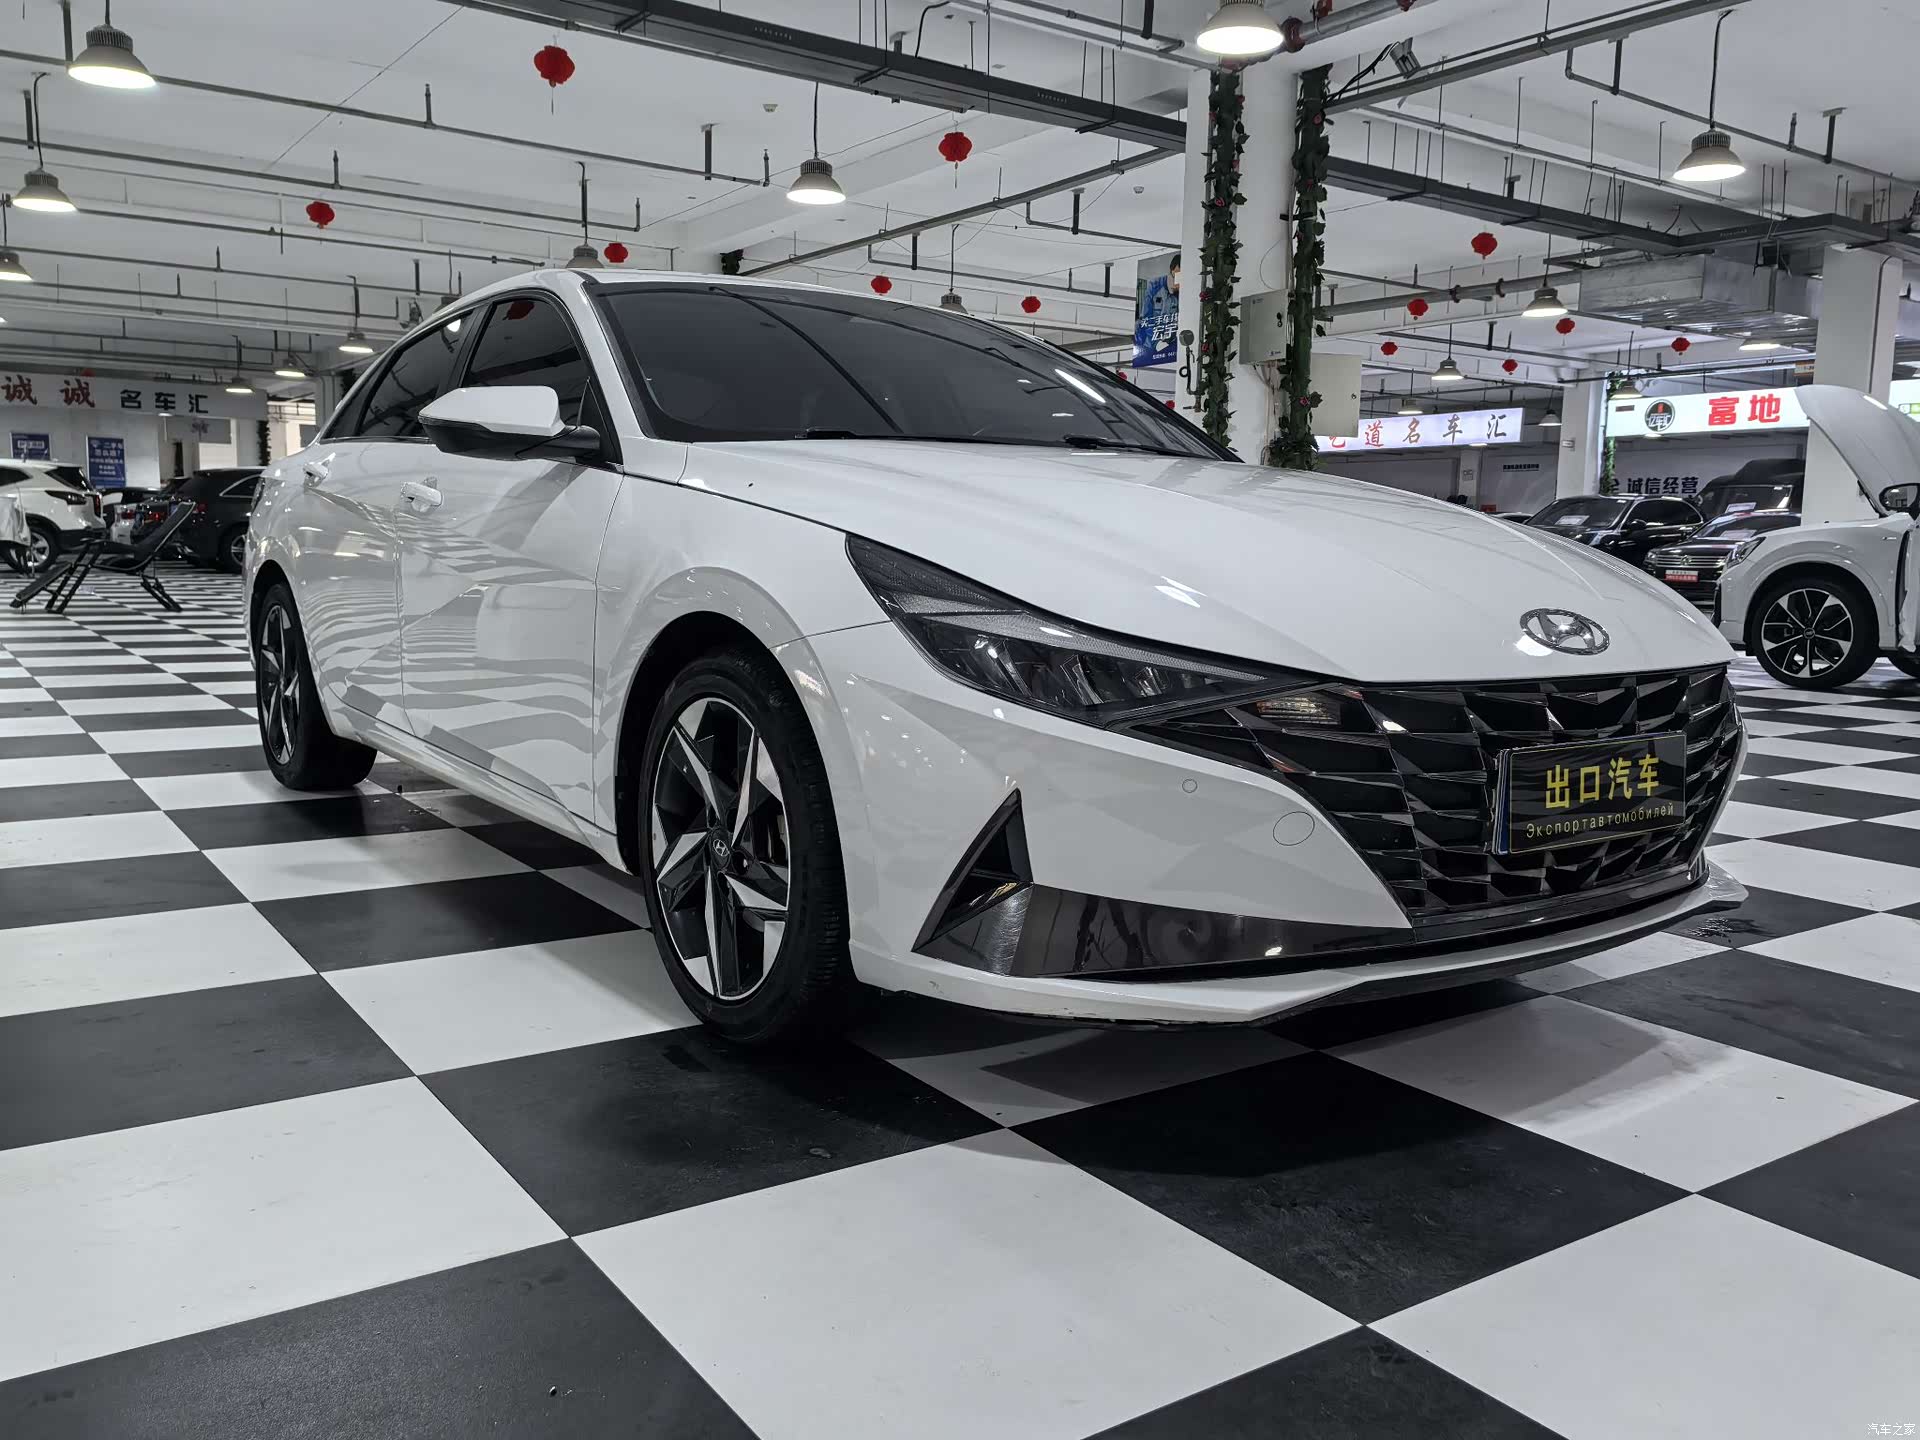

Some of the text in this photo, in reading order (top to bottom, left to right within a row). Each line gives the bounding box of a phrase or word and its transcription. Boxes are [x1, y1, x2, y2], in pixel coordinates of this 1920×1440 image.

[1708, 393, 1781, 426] 富地
[1545, 753, 1660, 808] 出口汽车
[1526, 802, 1674, 838] Экспортавтомобилей
